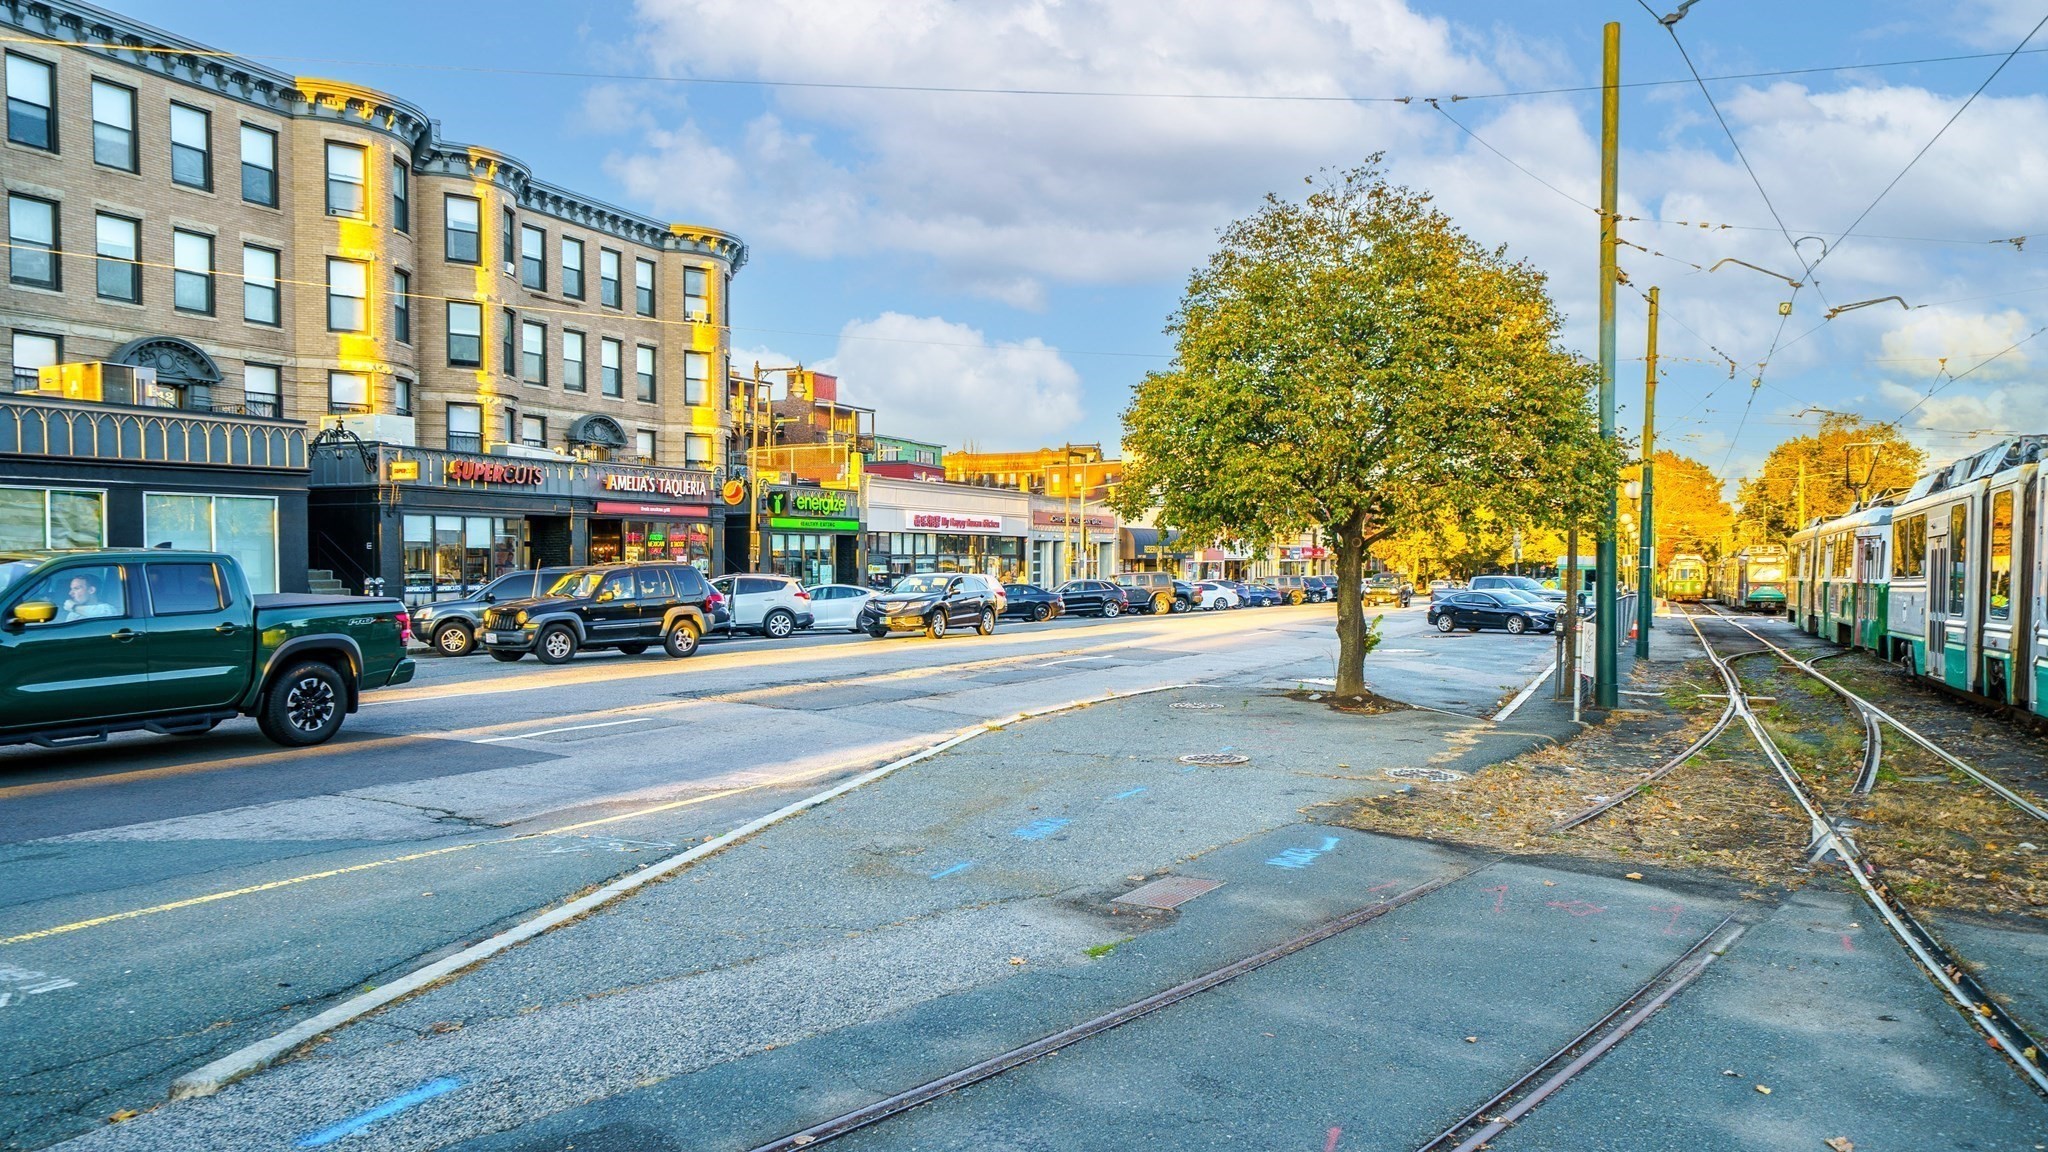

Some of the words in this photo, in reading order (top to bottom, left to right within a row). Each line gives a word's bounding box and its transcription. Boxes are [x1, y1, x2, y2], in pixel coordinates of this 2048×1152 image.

[450, 460, 544, 485] SUPERCUTS
[608, 475, 655, 492] AMELIA'S
[657, 478, 707, 497] TAQUERIA
[796, 492, 846, 515] energize
[941, 517, 949, 528] My
